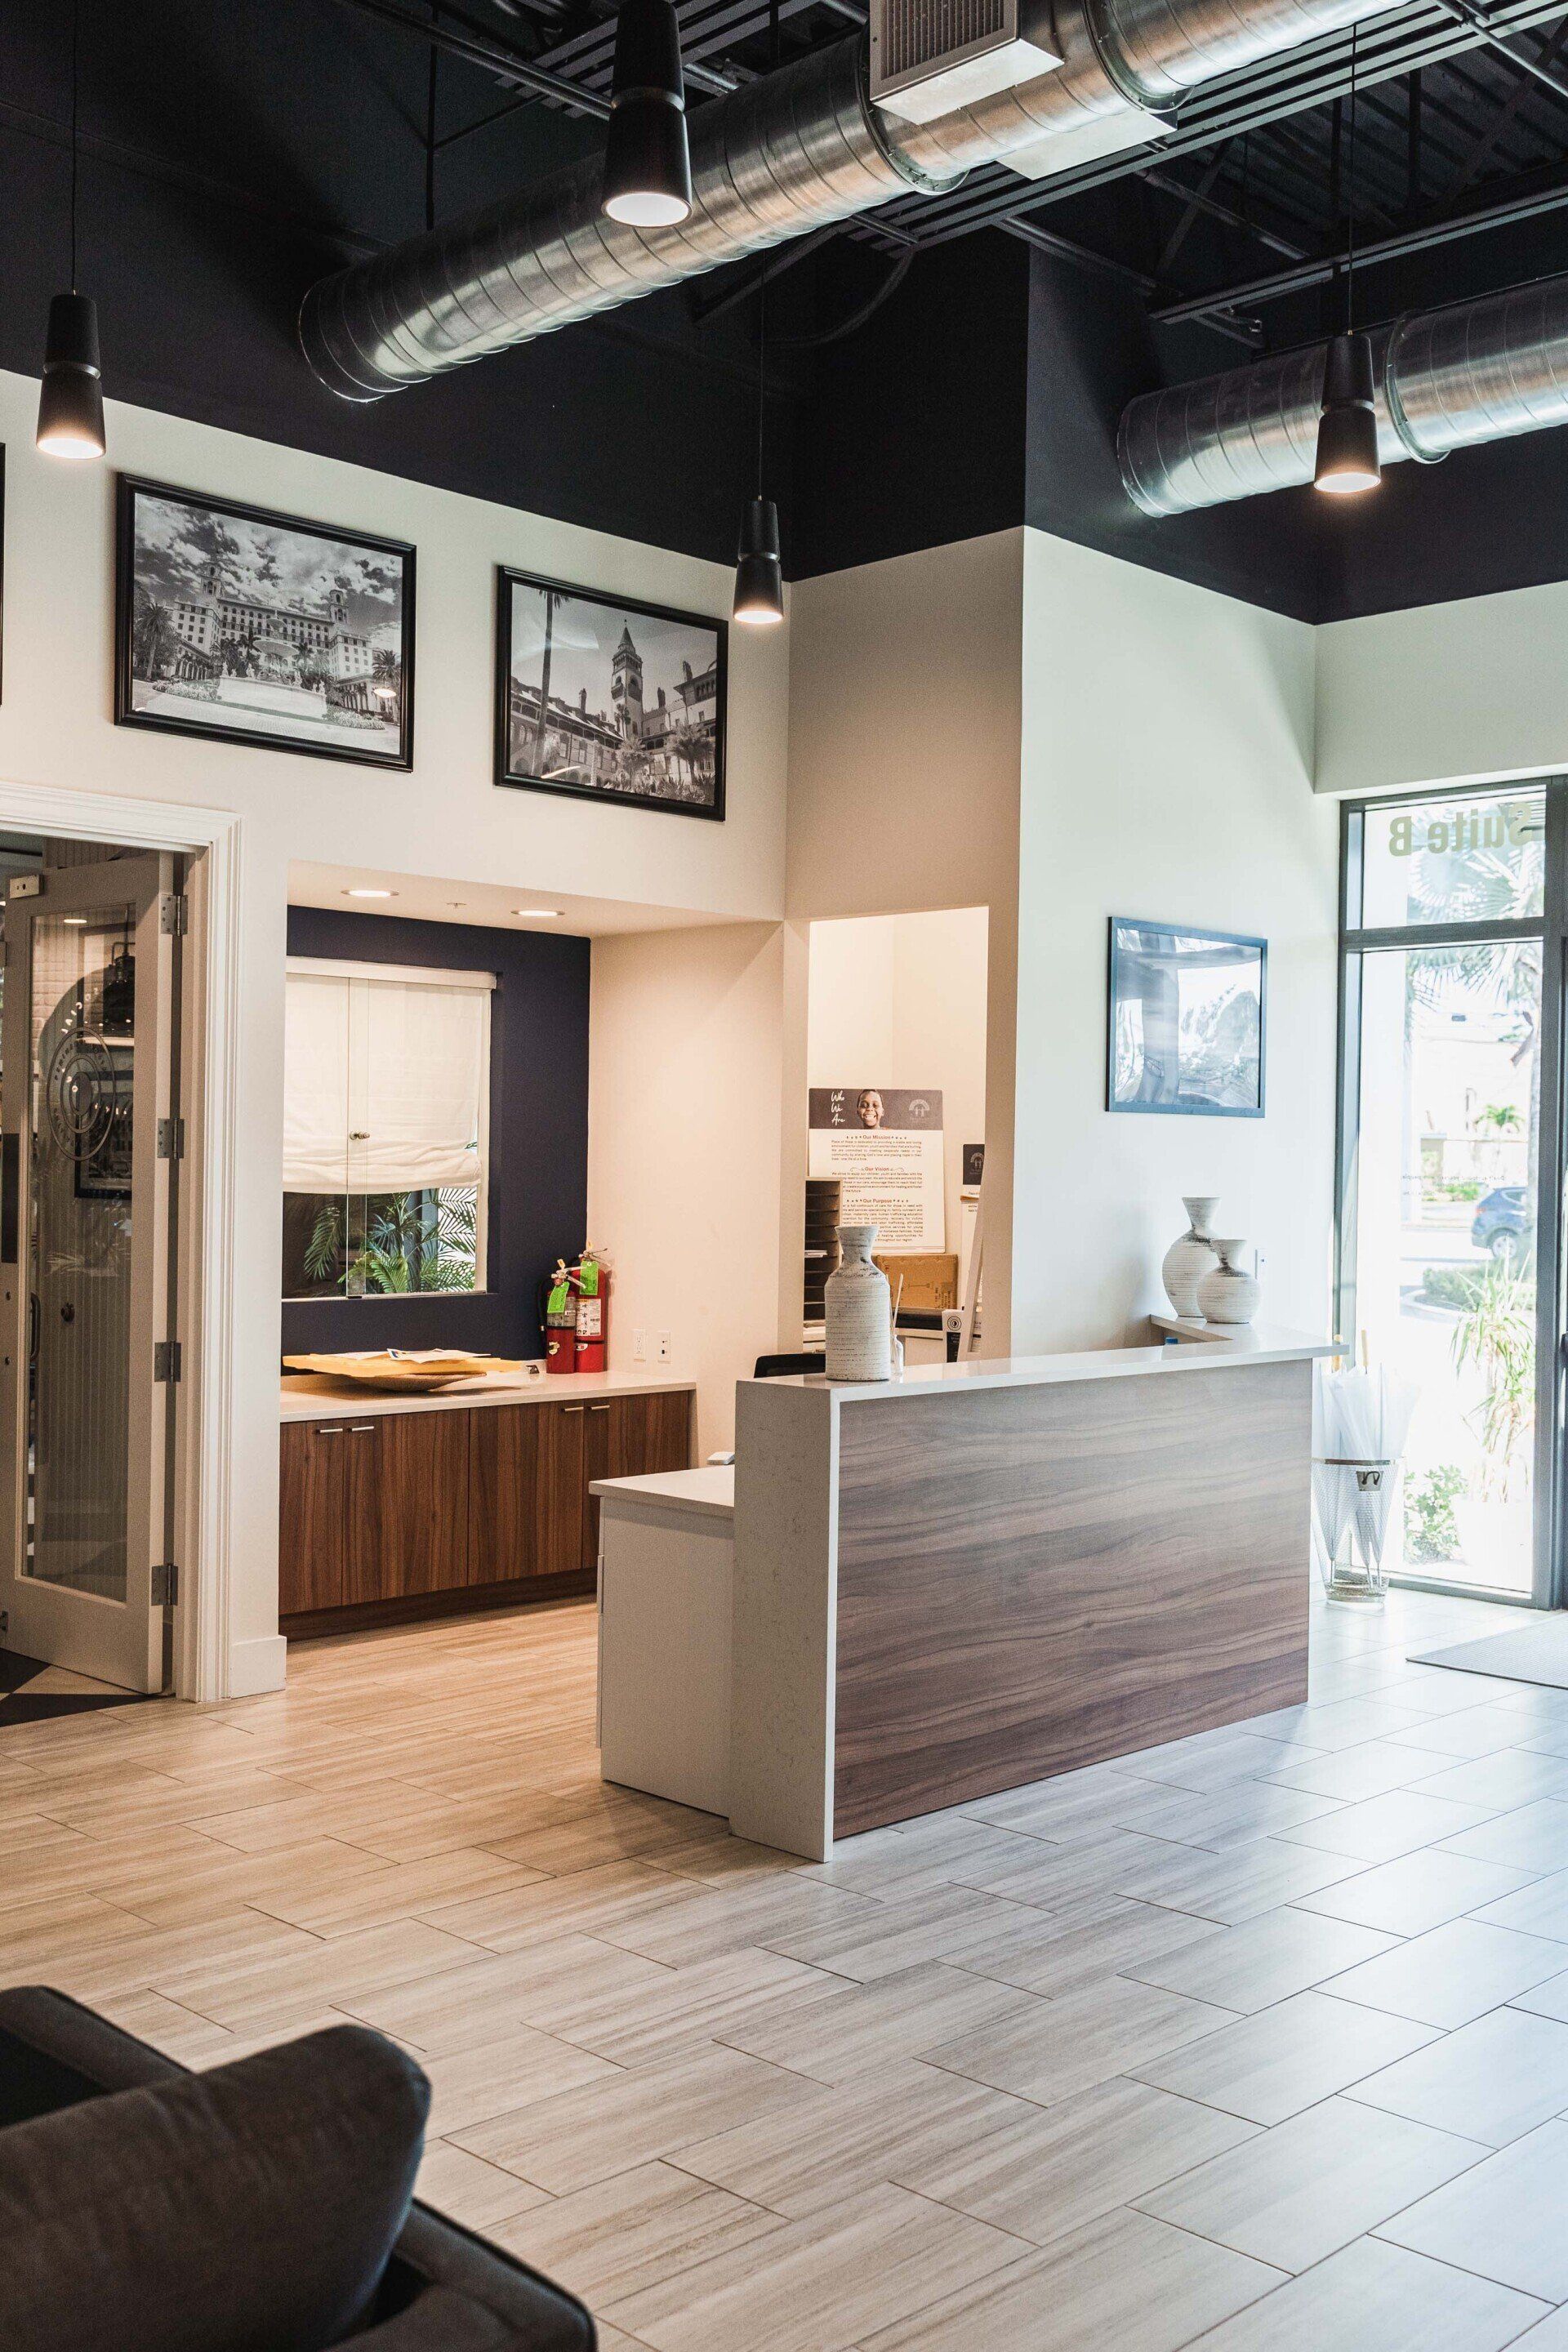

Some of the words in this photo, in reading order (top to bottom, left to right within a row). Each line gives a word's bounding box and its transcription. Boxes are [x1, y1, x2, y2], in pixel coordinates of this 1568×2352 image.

[831, 1090, 845, 1101] Who
[831, 1102, 843, 1113] We
[831, 1113, 846, 1126] Are
